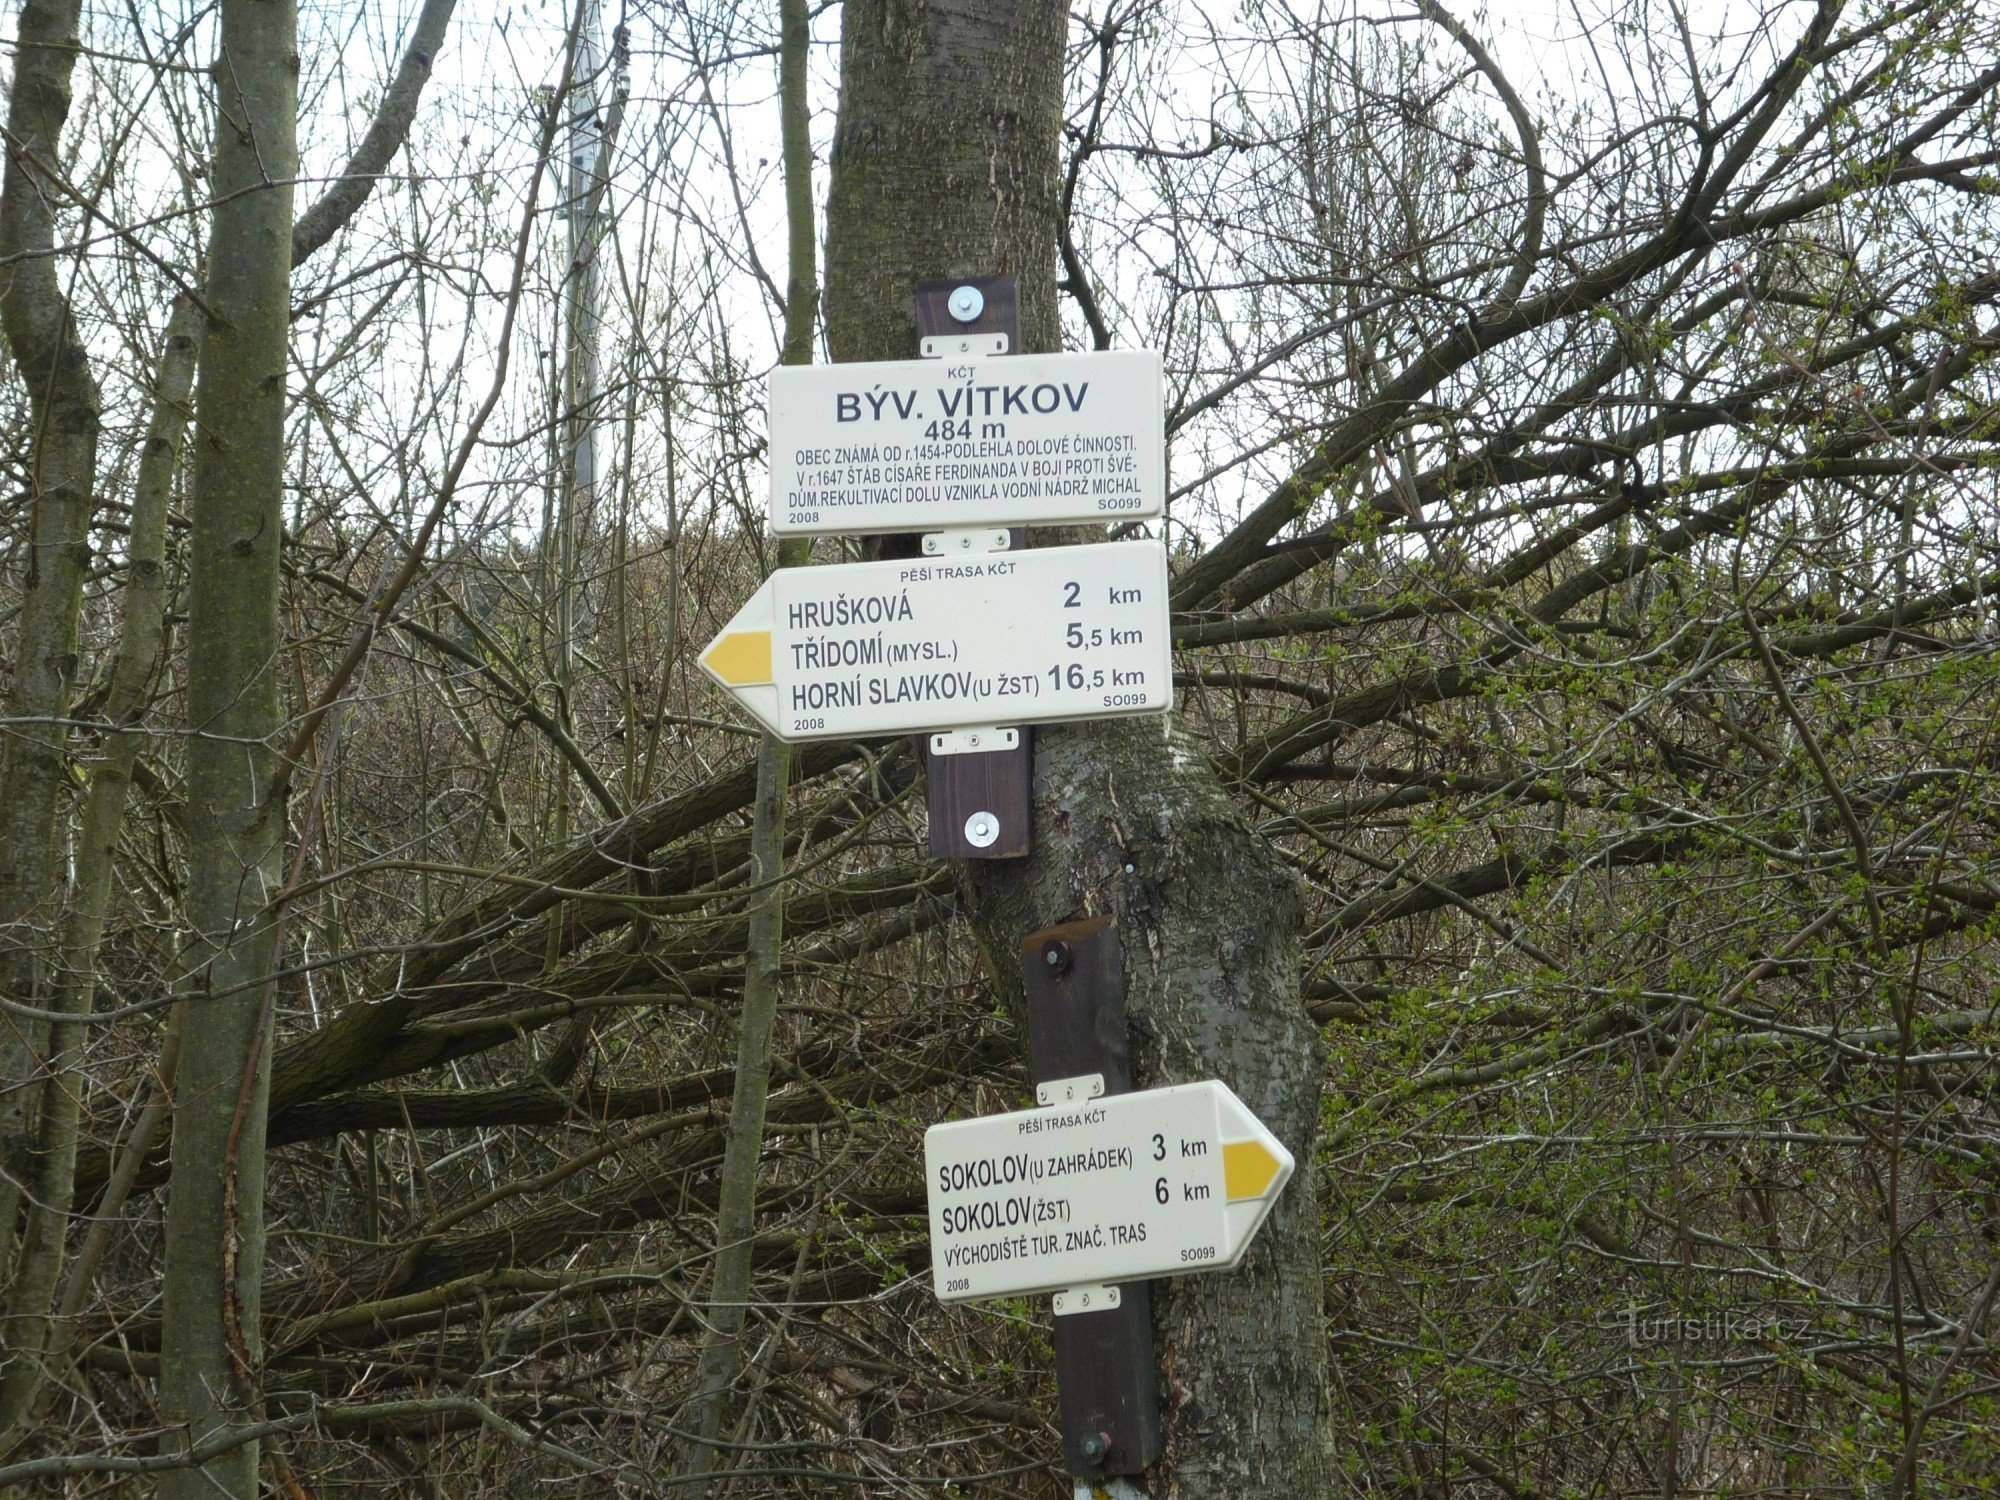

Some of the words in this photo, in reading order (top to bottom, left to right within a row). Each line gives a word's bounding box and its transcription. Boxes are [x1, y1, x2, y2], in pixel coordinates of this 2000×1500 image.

[947, 366, 976, 379] KČT
[836, 384, 923, 423] BÝV.
[937, 380, 1089, 417] VÍTKOV
[924, 420, 972, 441] 484
[982, 421, 1006, 438] m
[795, 450, 831, 466] OBEC
[834, 444, 880, 464] ZNÁMÁ
[883, 445, 902, 462] OD
[1017, 435, 1069, 456] DOLOVÉ
[1073, 435, 1137, 453] ČINNOSTI.
[796, 471, 805, 487] V
[847, 464, 881, 485] ŠTÁB
[884, 462, 931, 483] CÍSAŘE
[935, 461, 1017, 481] FERDINANDA
[1020, 461, 1029, 477] V
[1033, 459, 1062, 476] BOJI
[1065, 457, 1104, 475] PROTI
[1107, 452, 1137, 473] ŠVÉ-
[905, 484, 941, 502] DOLU
[944, 483, 999, 501] VZNIKLA
[1001, 478, 1042, 498] VODNÍ
[1045, 476, 1089, 496] NÁDRŽ
[1092, 477, 1142, 494] MICHAL
[789, 512, 820, 524] 2008
[900, 566, 932, 582] PĚŠÍ
[936, 564, 984, 580] TRASA
[987, 562, 1016, 576] KČT
[789, 588, 914, 630] HRUŠKOVÁ
[1063, 581, 1082, 608] 2
[1109, 587, 1142, 605] km
[1065, 622, 1103, 651] 5,5
[1110, 628, 1144, 646] km
[792, 674, 862, 711] HORNÍ
[997, 673, 1040, 698] ŽST)
[1047, 663, 1105, 692] 16,5
[1112, 669, 1145, 687] km
[794, 717, 825, 731] 2008
[1045, 1114, 1082, 1131] TRASA
[1084, 1109, 1106, 1125] KČT
[1047, 1147, 1133, 1178] ZAHRÁDEK)
[1152, 1133, 1167, 1162] 3
[1180, 1138, 1207, 1158] km
[1154, 1177, 1170, 1205] 6
[1183, 1182, 1210, 1201] km
[943, 1233, 1029, 1268] VÝCHODIŠTĚ
[1031, 1234, 1062, 1256] TUR.
[1065, 1223, 1107, 1251] ZNAČ.
[1109, 1222, 1147, 1246] TRAS
[946, 1278, 970, 1293] 2008
